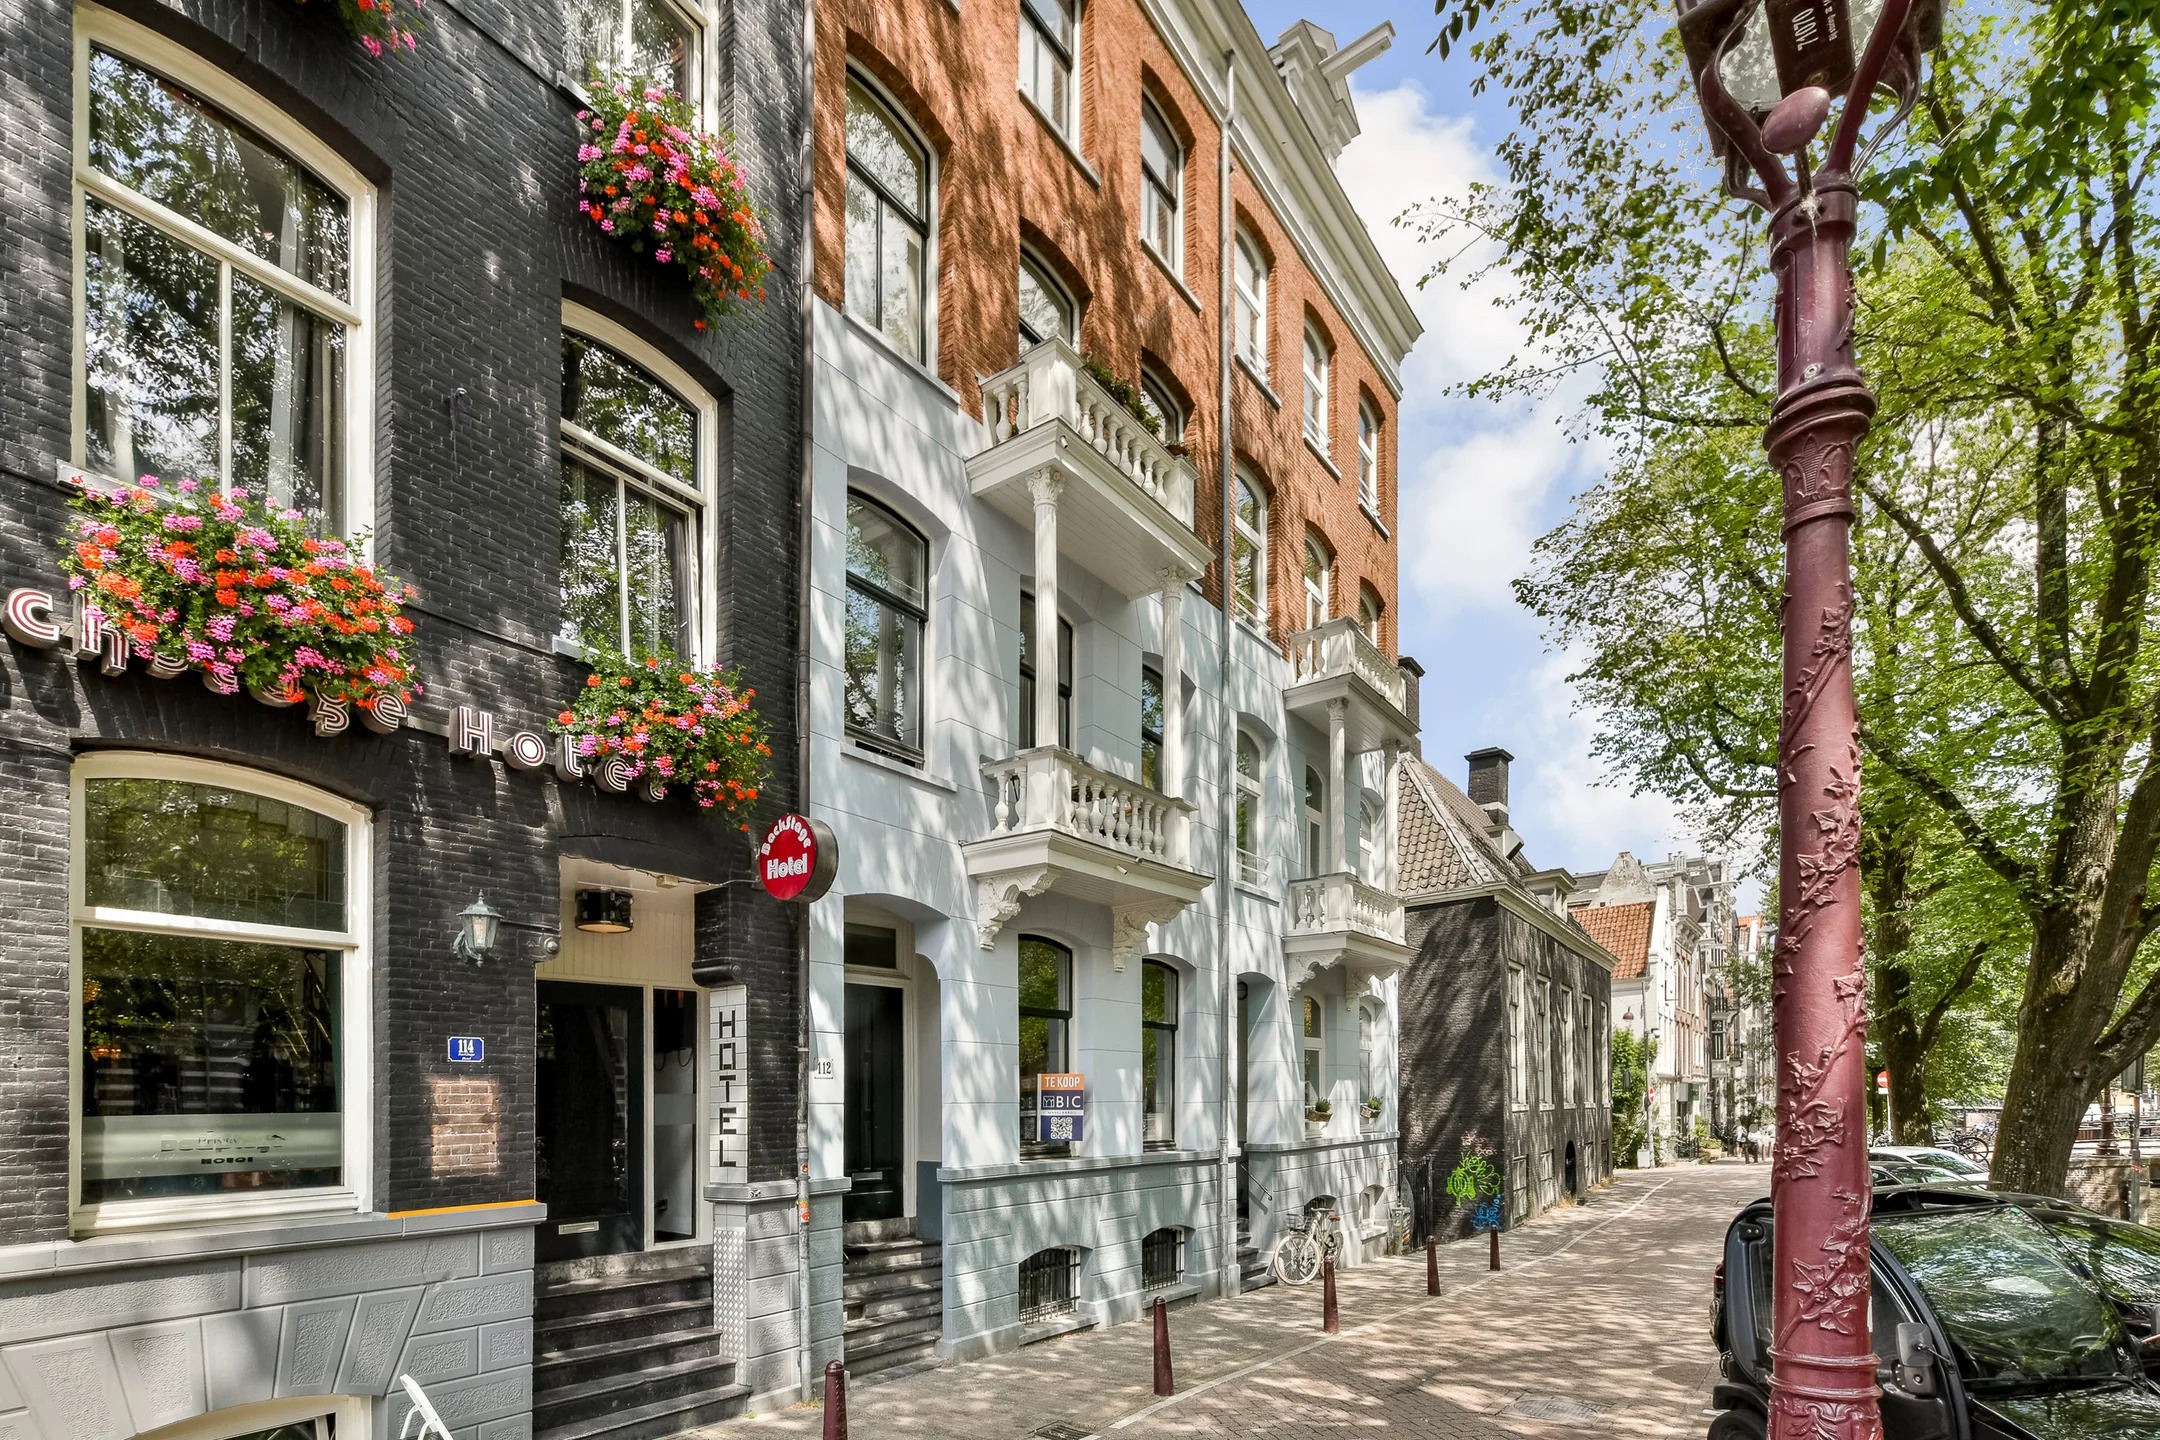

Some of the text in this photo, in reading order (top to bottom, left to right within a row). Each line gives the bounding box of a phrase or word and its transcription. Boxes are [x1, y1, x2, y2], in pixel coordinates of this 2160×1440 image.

[1792, 8, 1819, 51] 71070
[451, 706, 665, 802] Hote
[761, 815, 811, 855] Backstage
[767, 853, 808, 880] Hotel
[458, 1039, 474, 1053] 114
[818, 1061, 831, 1075] 112
[719, 1010, 736, 1167] HOTEL
[1045, 1077, 1080, 1088] TE KOOP
[1056, 1095, 1081, 1108] BIC
